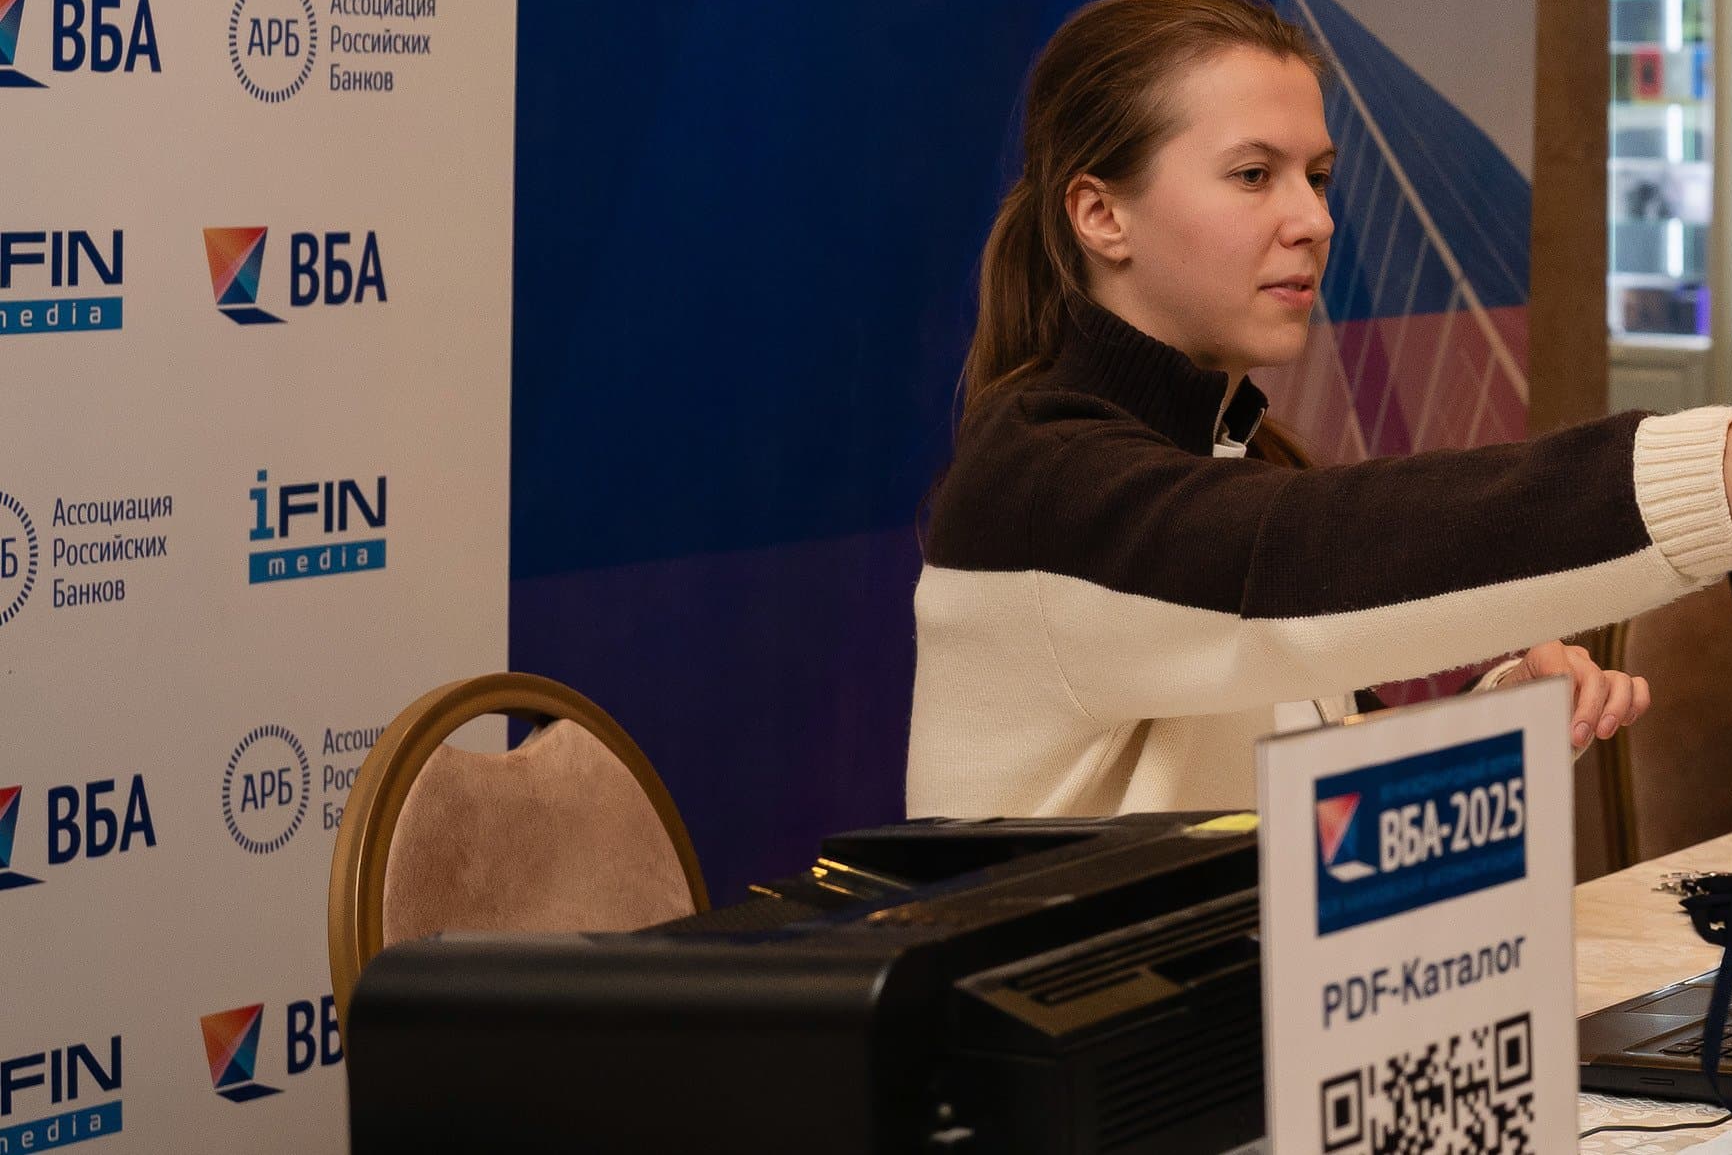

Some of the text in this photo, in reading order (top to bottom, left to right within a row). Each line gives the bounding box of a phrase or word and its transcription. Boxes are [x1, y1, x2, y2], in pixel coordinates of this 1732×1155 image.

[247, 17, 300, 58] АРБ
[330, 25, 431, 55] Российских
[329, 63, 394, 92] Банков
[290, 231, 388, 307] ВБА
[53, 495, 173, 527] Ассоциация
[249, 470, 387, 541] iFIN
[53, 534, 168, 568] Российских
[268, 546, 369, 577] media
[53, 578, 126, 608] Банков
[240, 767, 293, 813] АРБ
[47, 773, 157, 866] ВБА
[1378, 777, 1525, 874] ВБА-2025
[1323, 935, 1526, 1031] PDF-Каталог
